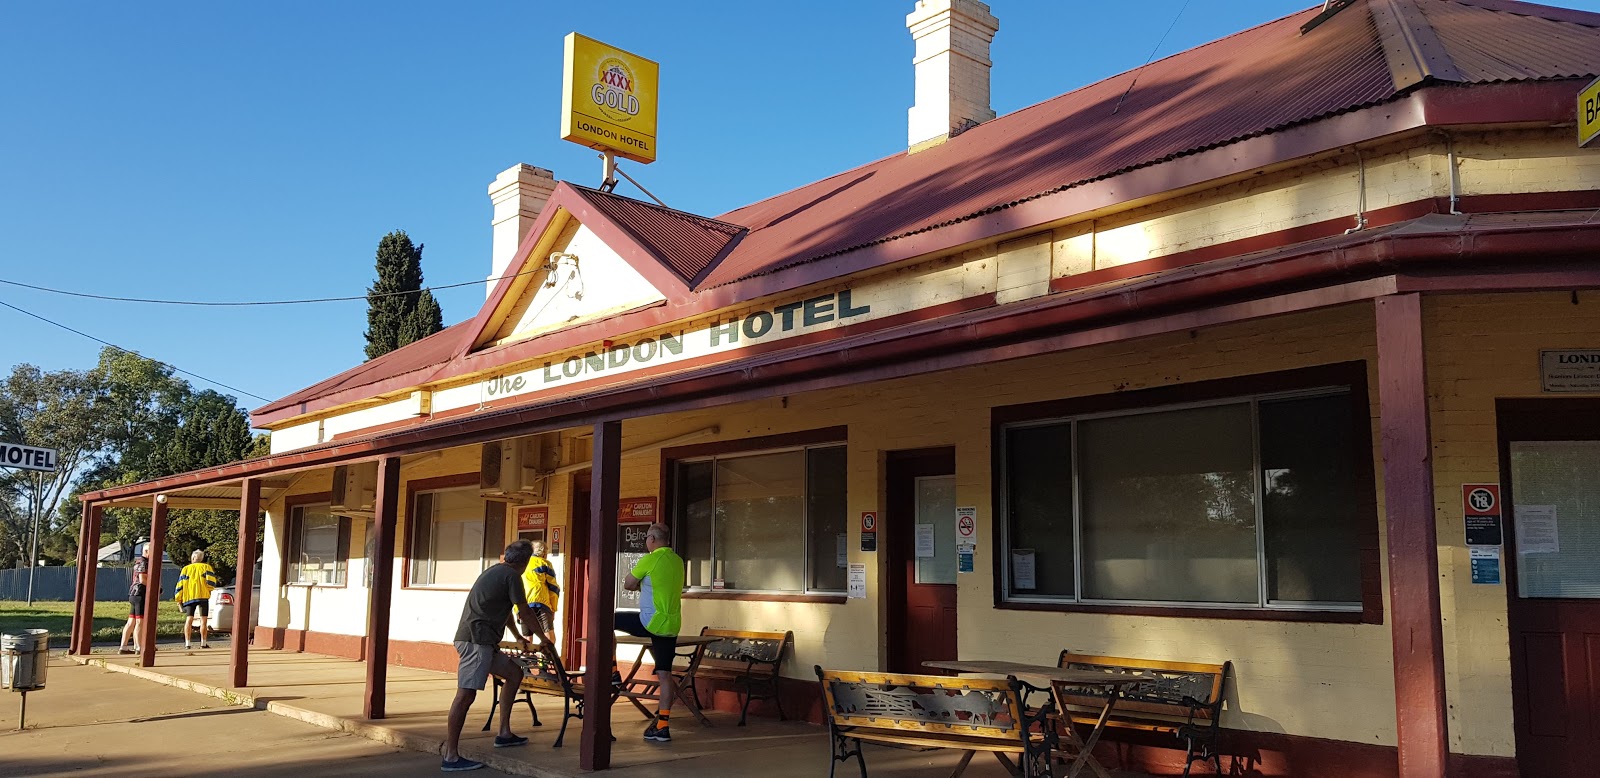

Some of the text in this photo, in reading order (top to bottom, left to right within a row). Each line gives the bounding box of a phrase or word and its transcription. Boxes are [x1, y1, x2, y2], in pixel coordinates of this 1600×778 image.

[600, 70, 632, 92] XXXX
[591, 83, 640, 116] GOLD
[577, 120, 649, 151] LONDON HOTEL
[487, 289, 870, 396] The LONDON HOTEL
[632, 509, 653, 517] DRAUGHT
